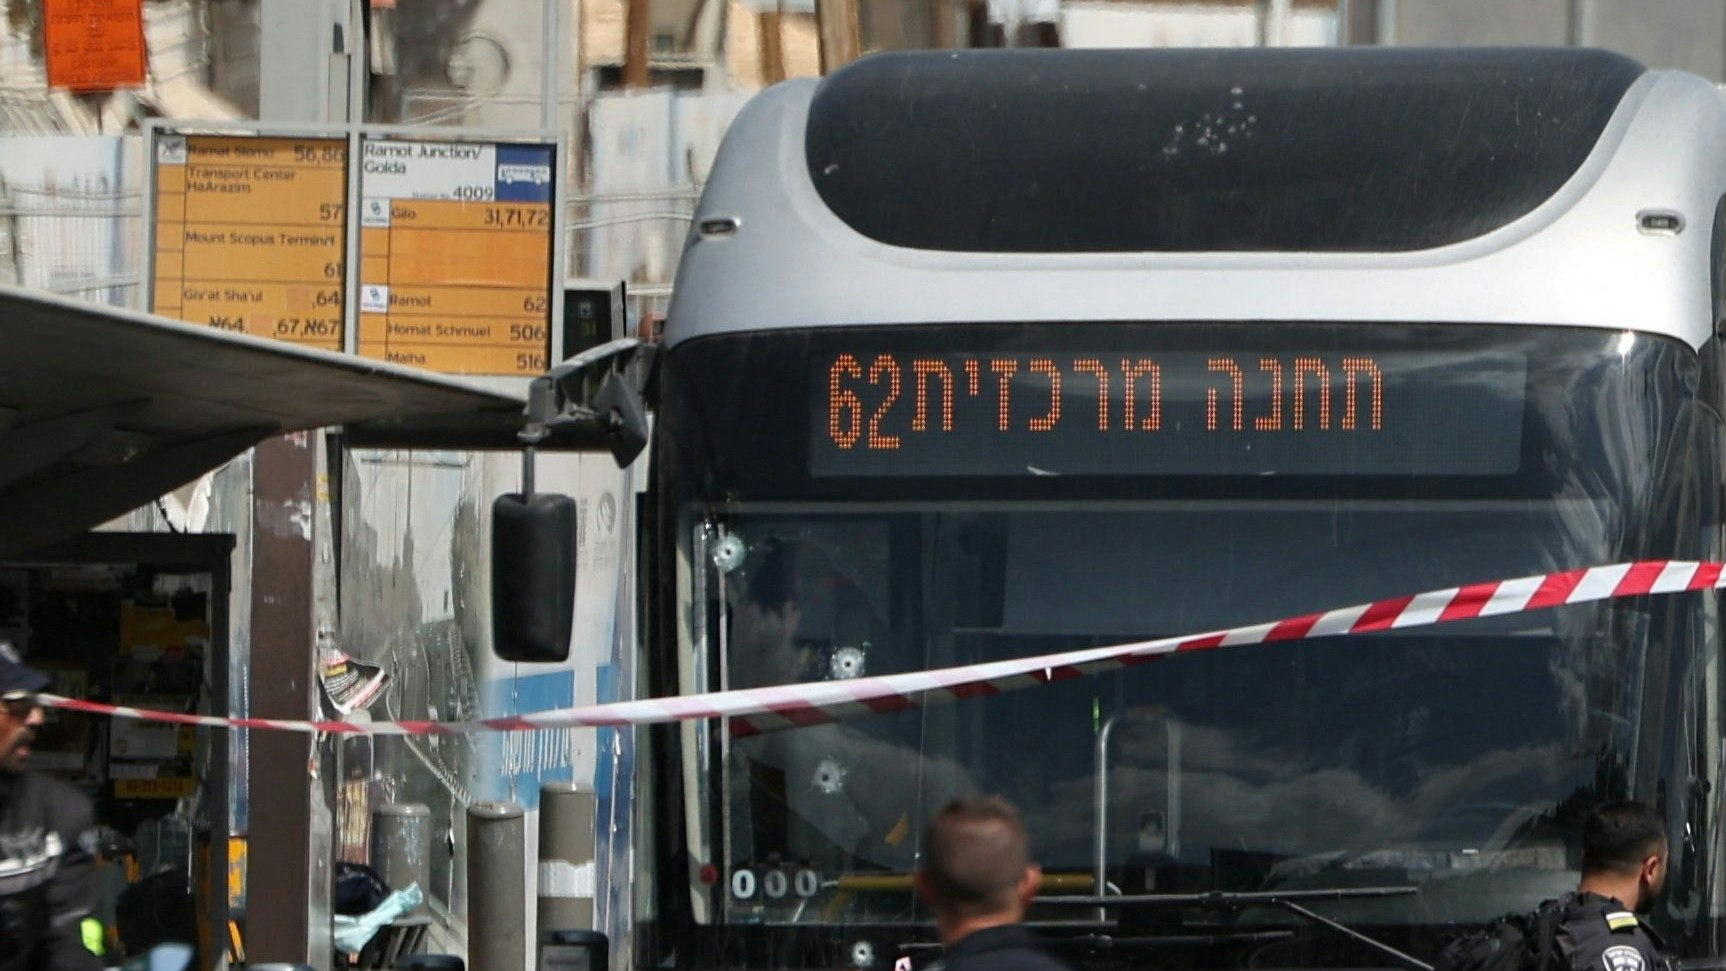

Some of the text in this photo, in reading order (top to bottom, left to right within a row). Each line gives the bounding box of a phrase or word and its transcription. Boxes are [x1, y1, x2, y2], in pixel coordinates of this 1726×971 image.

[364, 143, 413, 158] Ramot
[188, 166, 296, 181] Transport Center
[364, 161, 407, 175] Golda
[453, 185, 494, 200] 4009
[391, 207, 417, 220] Gilo
[185, 231, 225, 245] Mount
[230, 231, 275, 247] Scopus
[524, 297, 547, 312] 62
[510, 323, 546, 342] 506
[516, 354, 545, 371] 516
[829, 353, 1382, 450] תחנה מרכזית 62
